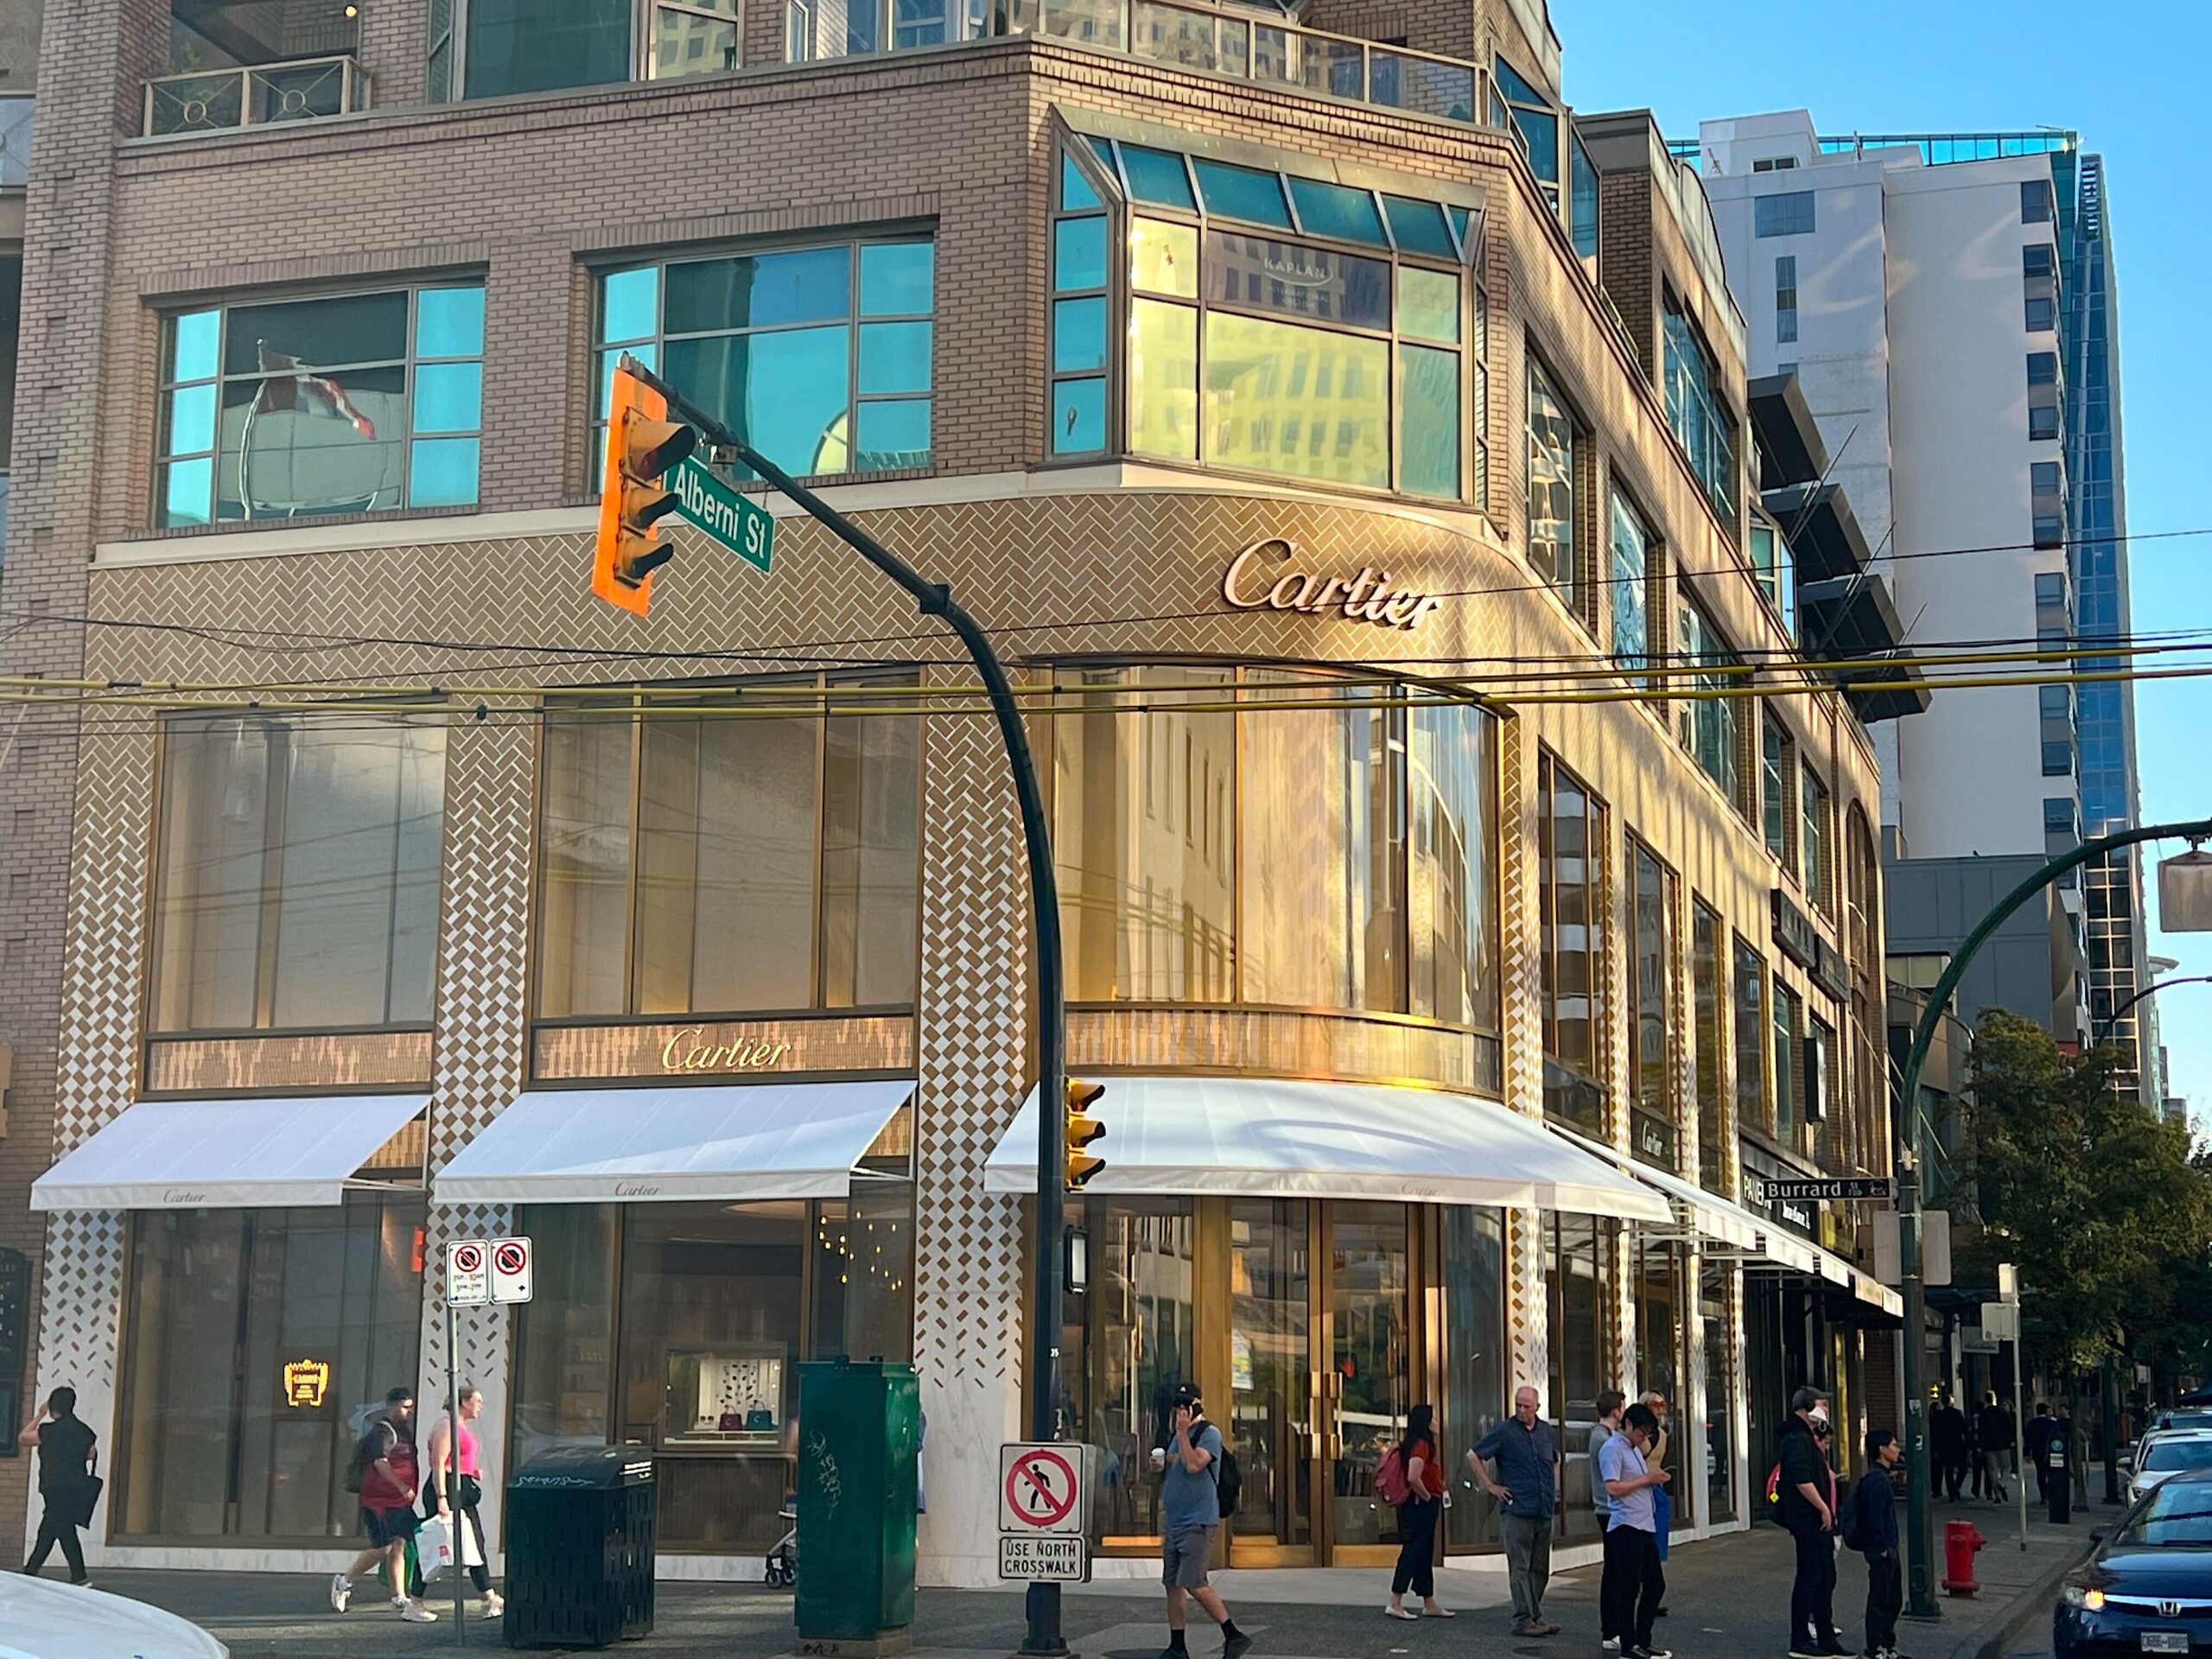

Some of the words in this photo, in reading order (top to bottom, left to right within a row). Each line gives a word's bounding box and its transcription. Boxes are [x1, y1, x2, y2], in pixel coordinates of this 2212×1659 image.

[1264, 258, 1325, 279] KAPLAN
[674, 463, 741, 541] Alberni
[746, 512, 766, 559] St
[1224, 537, 1444, 629] Cartier
[662, 1028, 791, 1070] Cartier
[1643, 1120, 1663, 1157] Cartier
[162, 1186, 207, 1204] Cartier
[615, 1180, 662, 1197] Cartier
[1768, 1181, 1841, 1198] Burrard
[1007, 1542, 1029, 1556] USE
[1037, 1541, 1077, 1557] NORTH
[1005, 1559, 1077, 1573] CROSSWALK
